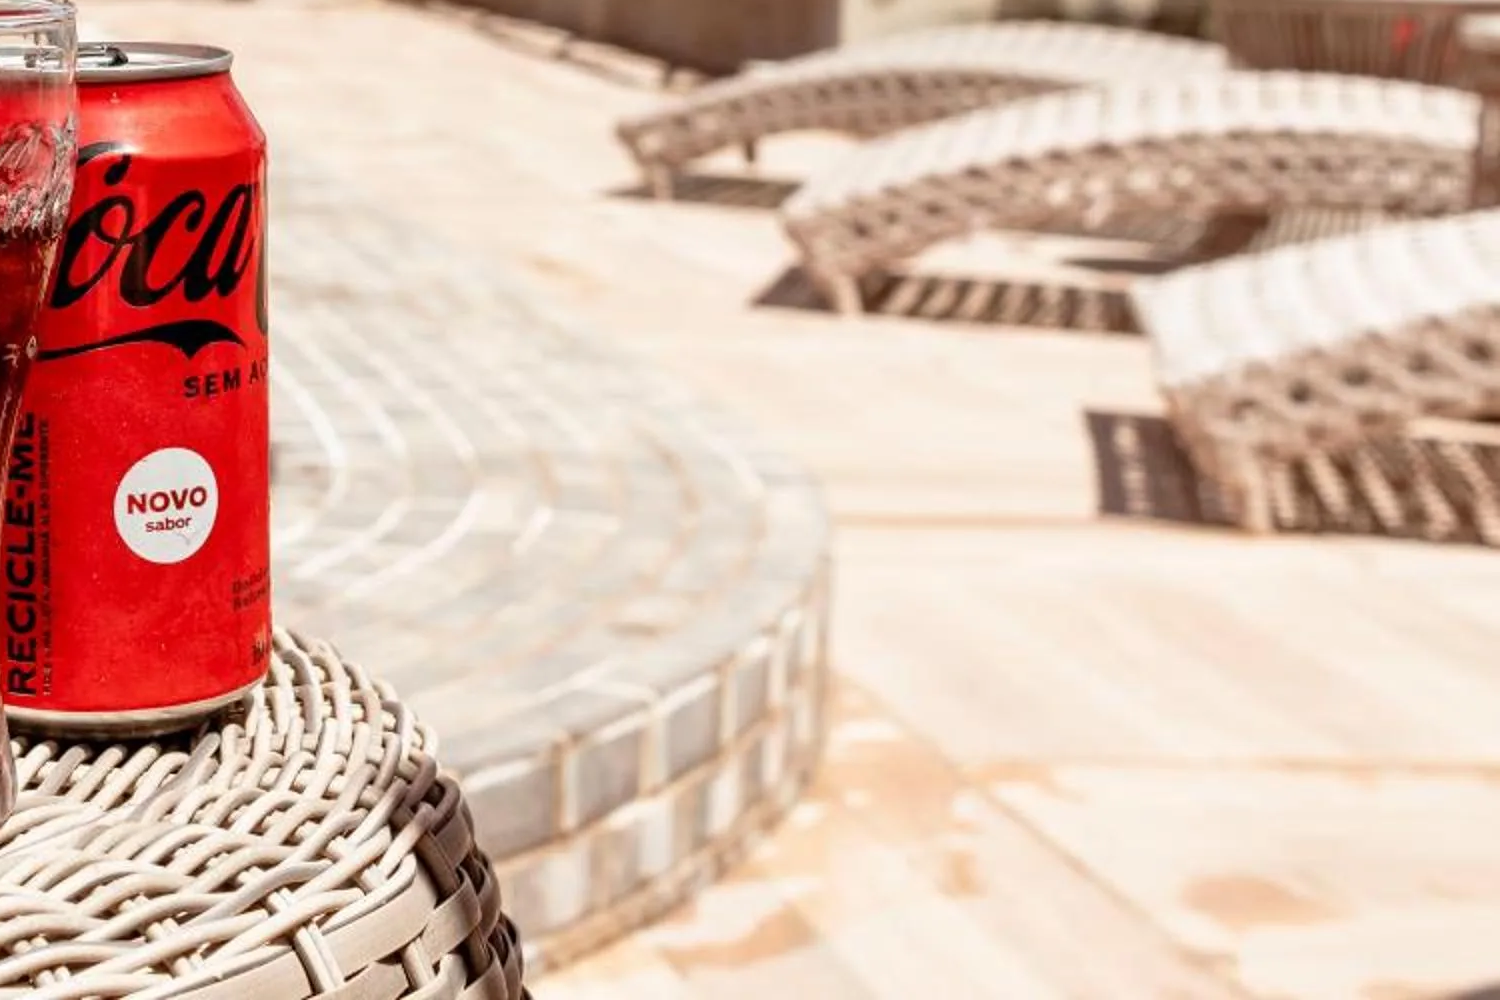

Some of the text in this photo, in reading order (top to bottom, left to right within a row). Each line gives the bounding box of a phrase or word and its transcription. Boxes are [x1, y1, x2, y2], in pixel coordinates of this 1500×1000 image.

[183, 367, 241, 398] SEM
[126, 485, 208, 515] NOVO
[145, 517, 192, 533] sabor
[6, 411, 38, 696] RECICLE-ME
